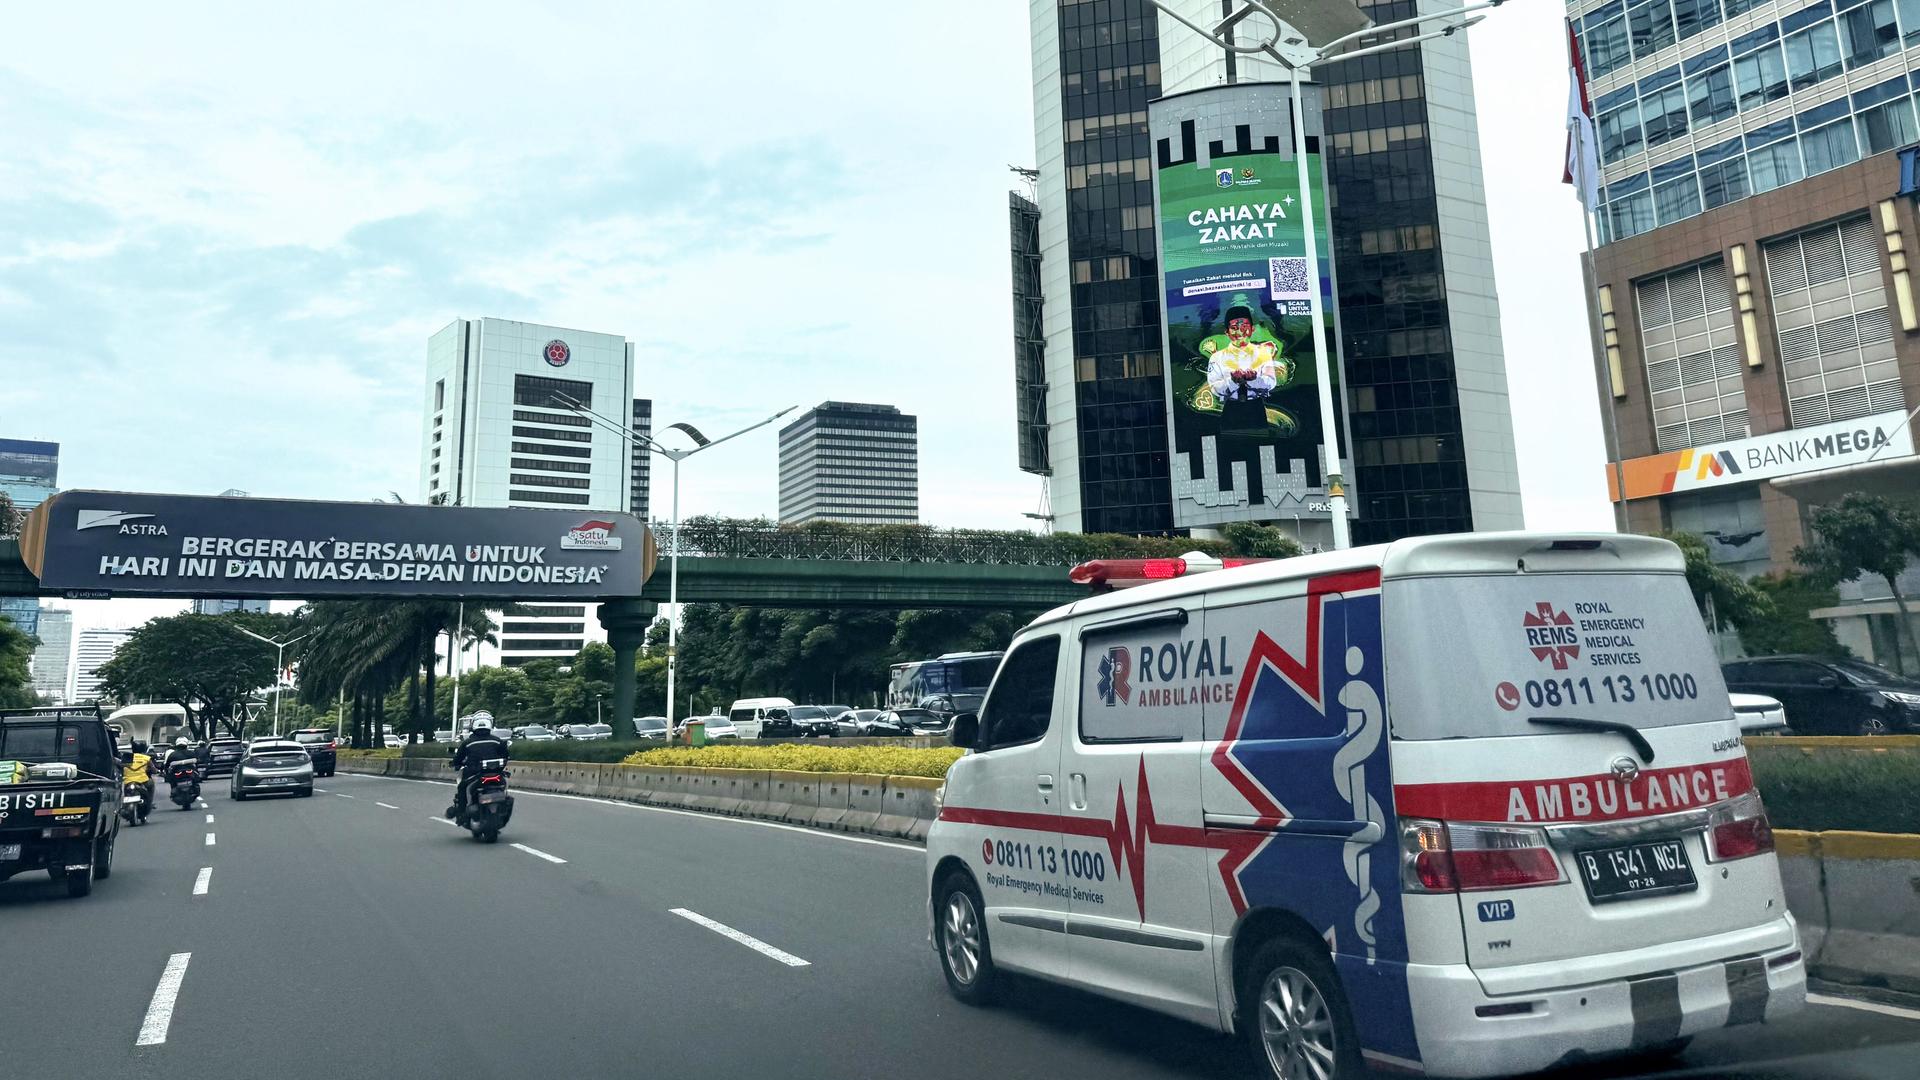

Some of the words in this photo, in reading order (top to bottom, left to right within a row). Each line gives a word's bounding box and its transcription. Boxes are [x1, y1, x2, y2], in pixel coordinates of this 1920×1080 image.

[1188, 203, 1287, 227] CAHAYA
[1198, 222, 1278, 245] ZAKAT
[119, 523, 168, 536] ASTRA
[181, 536, 325, 559] BERGERAK
[333, 541, 457, 563] BERSAMA
[465, 545, 546, 564] UNTUK
[99, 555, 170, 576] HARI
[178, 558, 216, 577] INI
[225, 559, 289, 579] DAN
[294, 561, 370, 581] MASA
[381, 563, 466, 583] DEPAN
[471, 565, 602, 585] INDONESIA
[1575, 602, 1613, 614] ROYAL
[1525, 627, 1578, 647] REMS
[1580, 618, 1645, 632] EMERGENCY
[1585, 636, 1635, 649] MEDICAL
[1138, 636, 1233, 683] ROYAL
[1590, 652, 1641, 667] SERVICES
[1138, 683, 1233, 707] AMBULANCE
[1525, 676, 1595, 708] 0811
[1601, 674, 1636, 703] 13
[1640, 673, 1698, 701] 1000
[0, 792, 65, 811] BISHI
[1507, 768, 1731, 823] AMBULANCE
[996, 839, 1032, 870] 0811
[1037, 845, 1057, 874] 13
[1061, 848, 1105, 882] 1000
[1585, 855, 1600, 881] B
[1608, 848, 1647, 878] 1541
[1652, 844, 1686, 872] NGZ
[986, 872, 1005, 888] Royal
[1006, 875, 1042, 896] Emergency
[1043, 881, 1072, 898] Medical
[1073, 887, 1104, 904] Services
[1482, 902, 1510, 919] VIP
